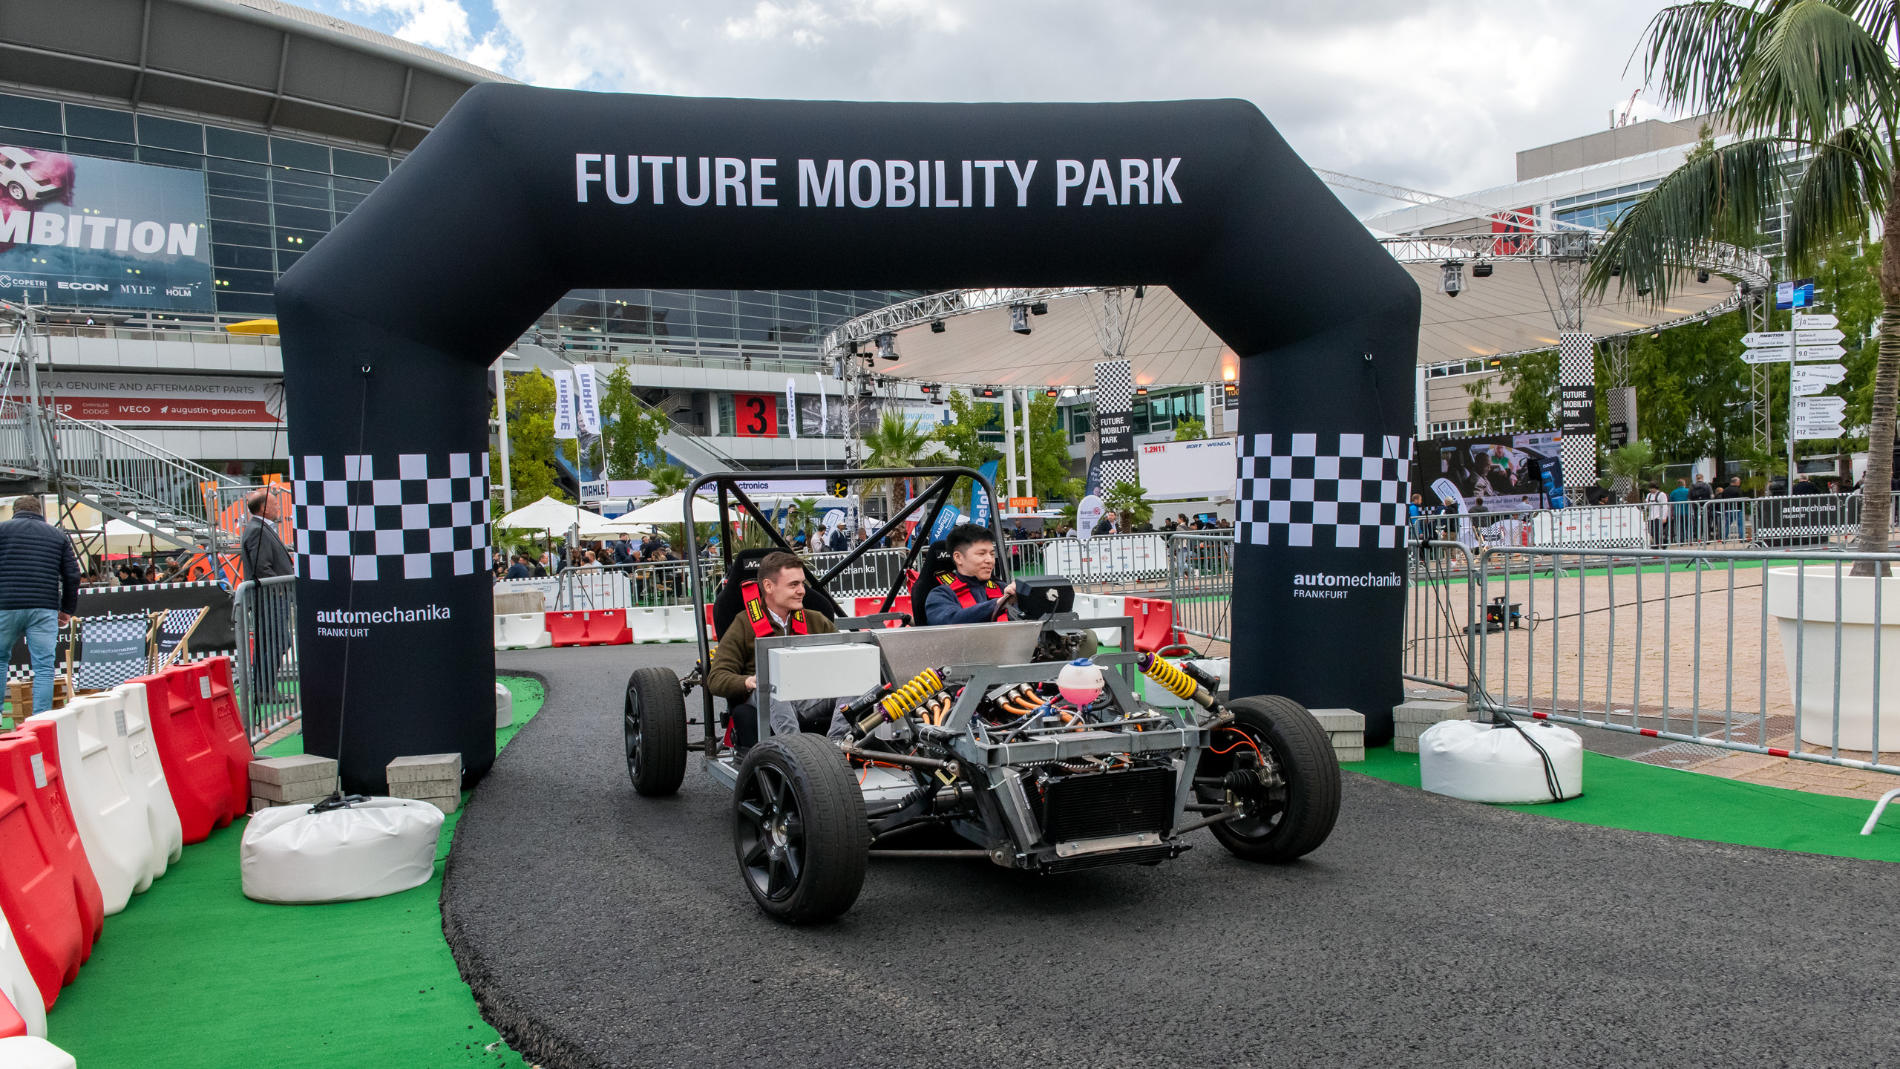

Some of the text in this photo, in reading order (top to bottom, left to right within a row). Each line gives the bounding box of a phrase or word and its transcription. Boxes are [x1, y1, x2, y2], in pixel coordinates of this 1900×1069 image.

[575, 152, 1183, 208] FUTURE MOBILITY PARK
[0, 209, 199, 257] MBITION
[12, 278, 47, 287] COPETRI
[57, 281, 109, 291] ECON
[165, 288, 192, 297] HOLM
[66, 381, 116, 391] GENUINE
[118, 382, 143, 392] AND
[145, 383, 221, 394] AFTERMARKET
[223, 385, 255, 395] PARTS
[1562, 390, 1587, 399] FUTURE
[118, 405, 151, 413] IVECO
[1563, 400, 1593, 408] MOBILITY
[170, 406, 257, 416] augustin-group.com
[746, 397, 768, 435] 3
[1563, 409, 1580, 417] PARK
[1100, 417, 1125, 426] FUTURE
[1100, 425, 1131, 435] MOBILITY
[1101, 435, 1118, 444] PARK
[581, 483, 605, 497] MAHLE
[975, 482, 989, 528] Delph
[1293, 571, 1401, 587] automechanika
[1293, 589, 1349, 599] FRANKFURT
[316, 604, 451, 624] automechanika
[317, 627, 370, 638] FRANKFURT
